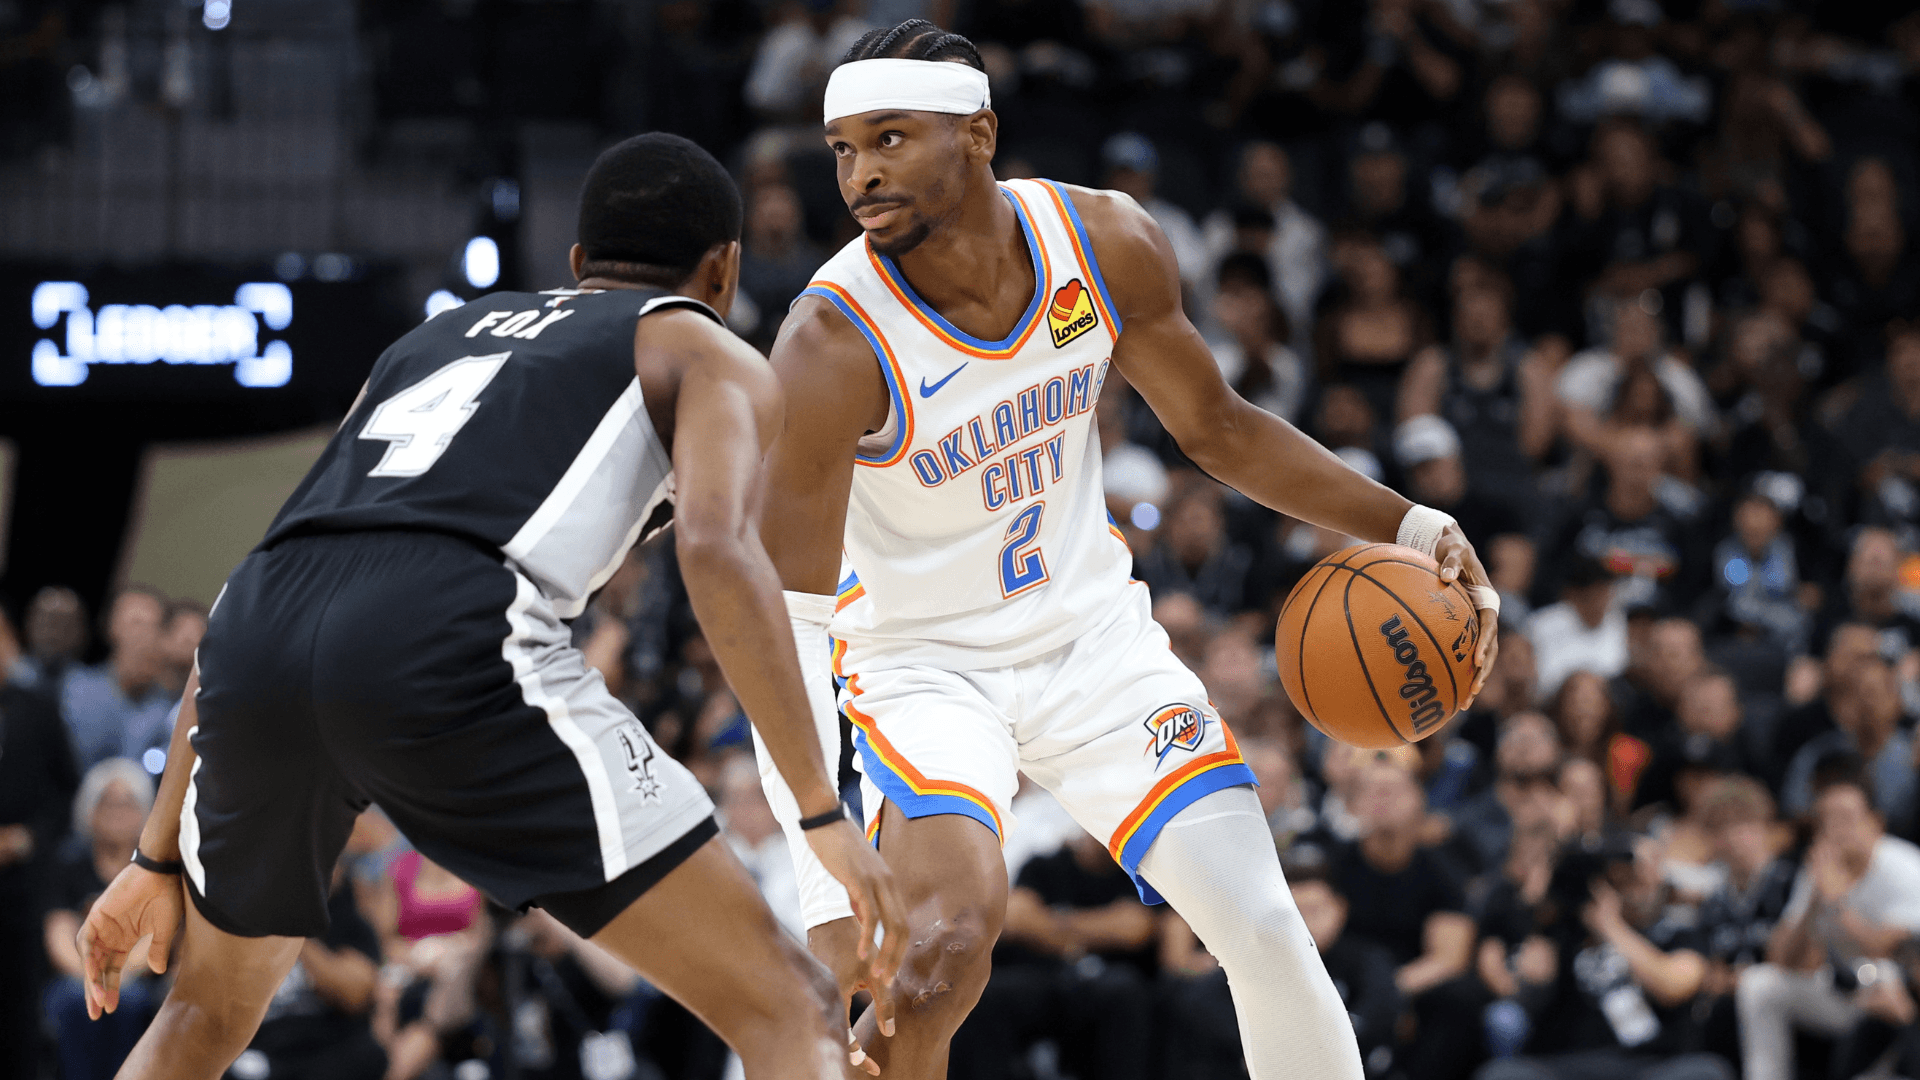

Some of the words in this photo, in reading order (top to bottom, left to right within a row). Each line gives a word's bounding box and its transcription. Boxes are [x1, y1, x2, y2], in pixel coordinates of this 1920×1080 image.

[464, 309, 576, 340] FOX
[358, 351, 512, 477] 4
[909, 357, 1111, 488] OKLAHOMA
[981, 430, 1066, 512] CITY
[998, 500, 1050, 600] 2
[1379, 612, 1446, 736] Wilson
[1155, 710, 1196, 758] OKC
